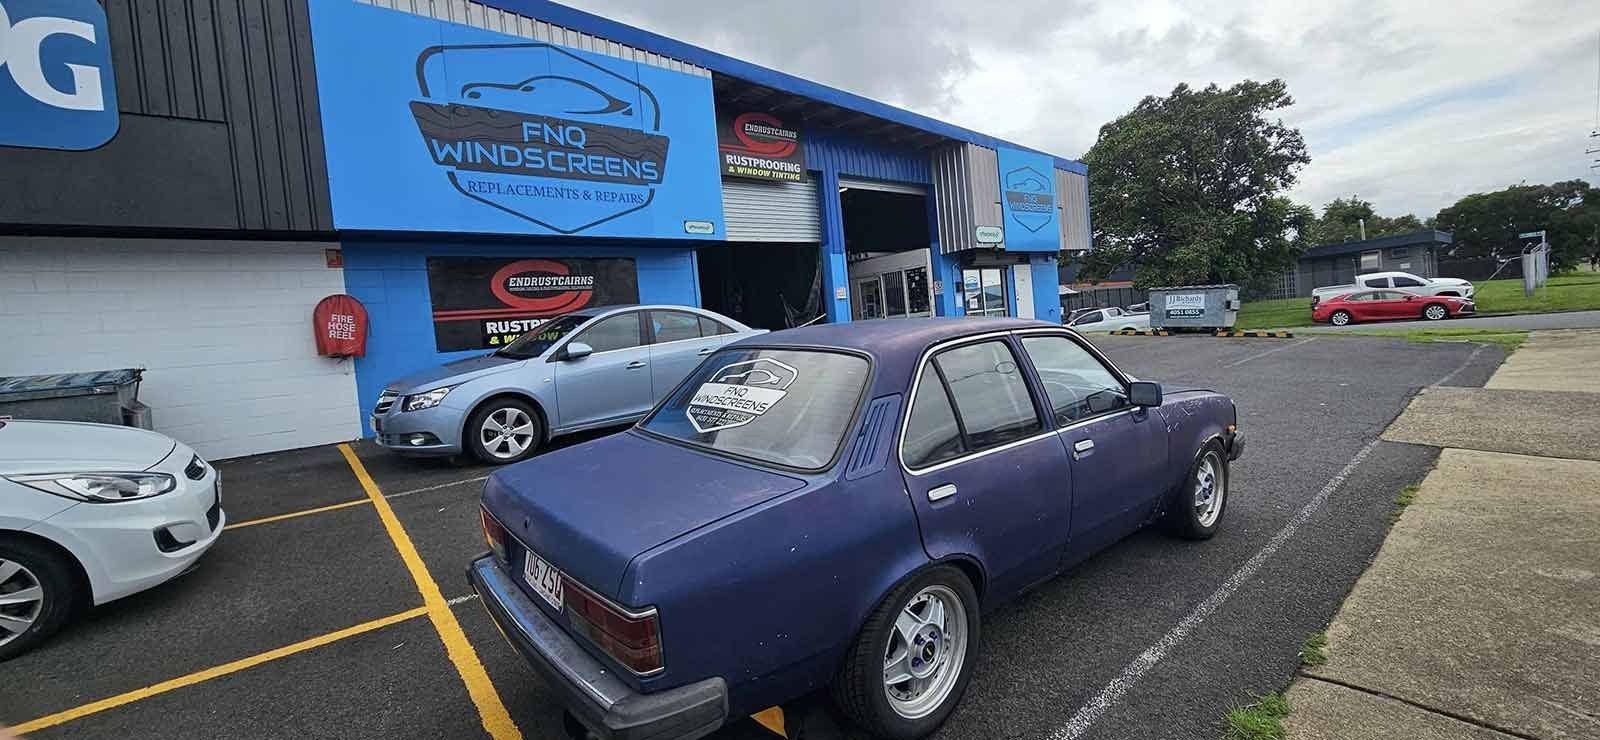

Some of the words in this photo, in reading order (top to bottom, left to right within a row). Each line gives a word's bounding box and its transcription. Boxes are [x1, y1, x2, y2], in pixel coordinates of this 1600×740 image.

[521, 121, 587, 149] FNQ
[745, 123, 797, 139] ENDRUSTCAIRNS
[431, 139, 659, 180] WINDSCREENS
[726, 154, 801, 173] RUSTPROOFING
[736, 167, 771, 177] WINDOW
[772, 171, 800, 181] TINTING
[467, 180, 580, 201] REPLACEMENTS
[583, 190, 592, 200] &
[595, 191, 644, 204] REPAIRS
[509, 276, 594, 287] ENDRUSTCAIRNS
[331, 313, 354, 324] FIRE
[328, 322, 356, 332] HOSE
[329, 330, 355, 340] REEL
[489, 336, 499, 345] &
[724, 386, 748, 397] FNQ
[693, 394, 768, 413] WINDSCREENS
